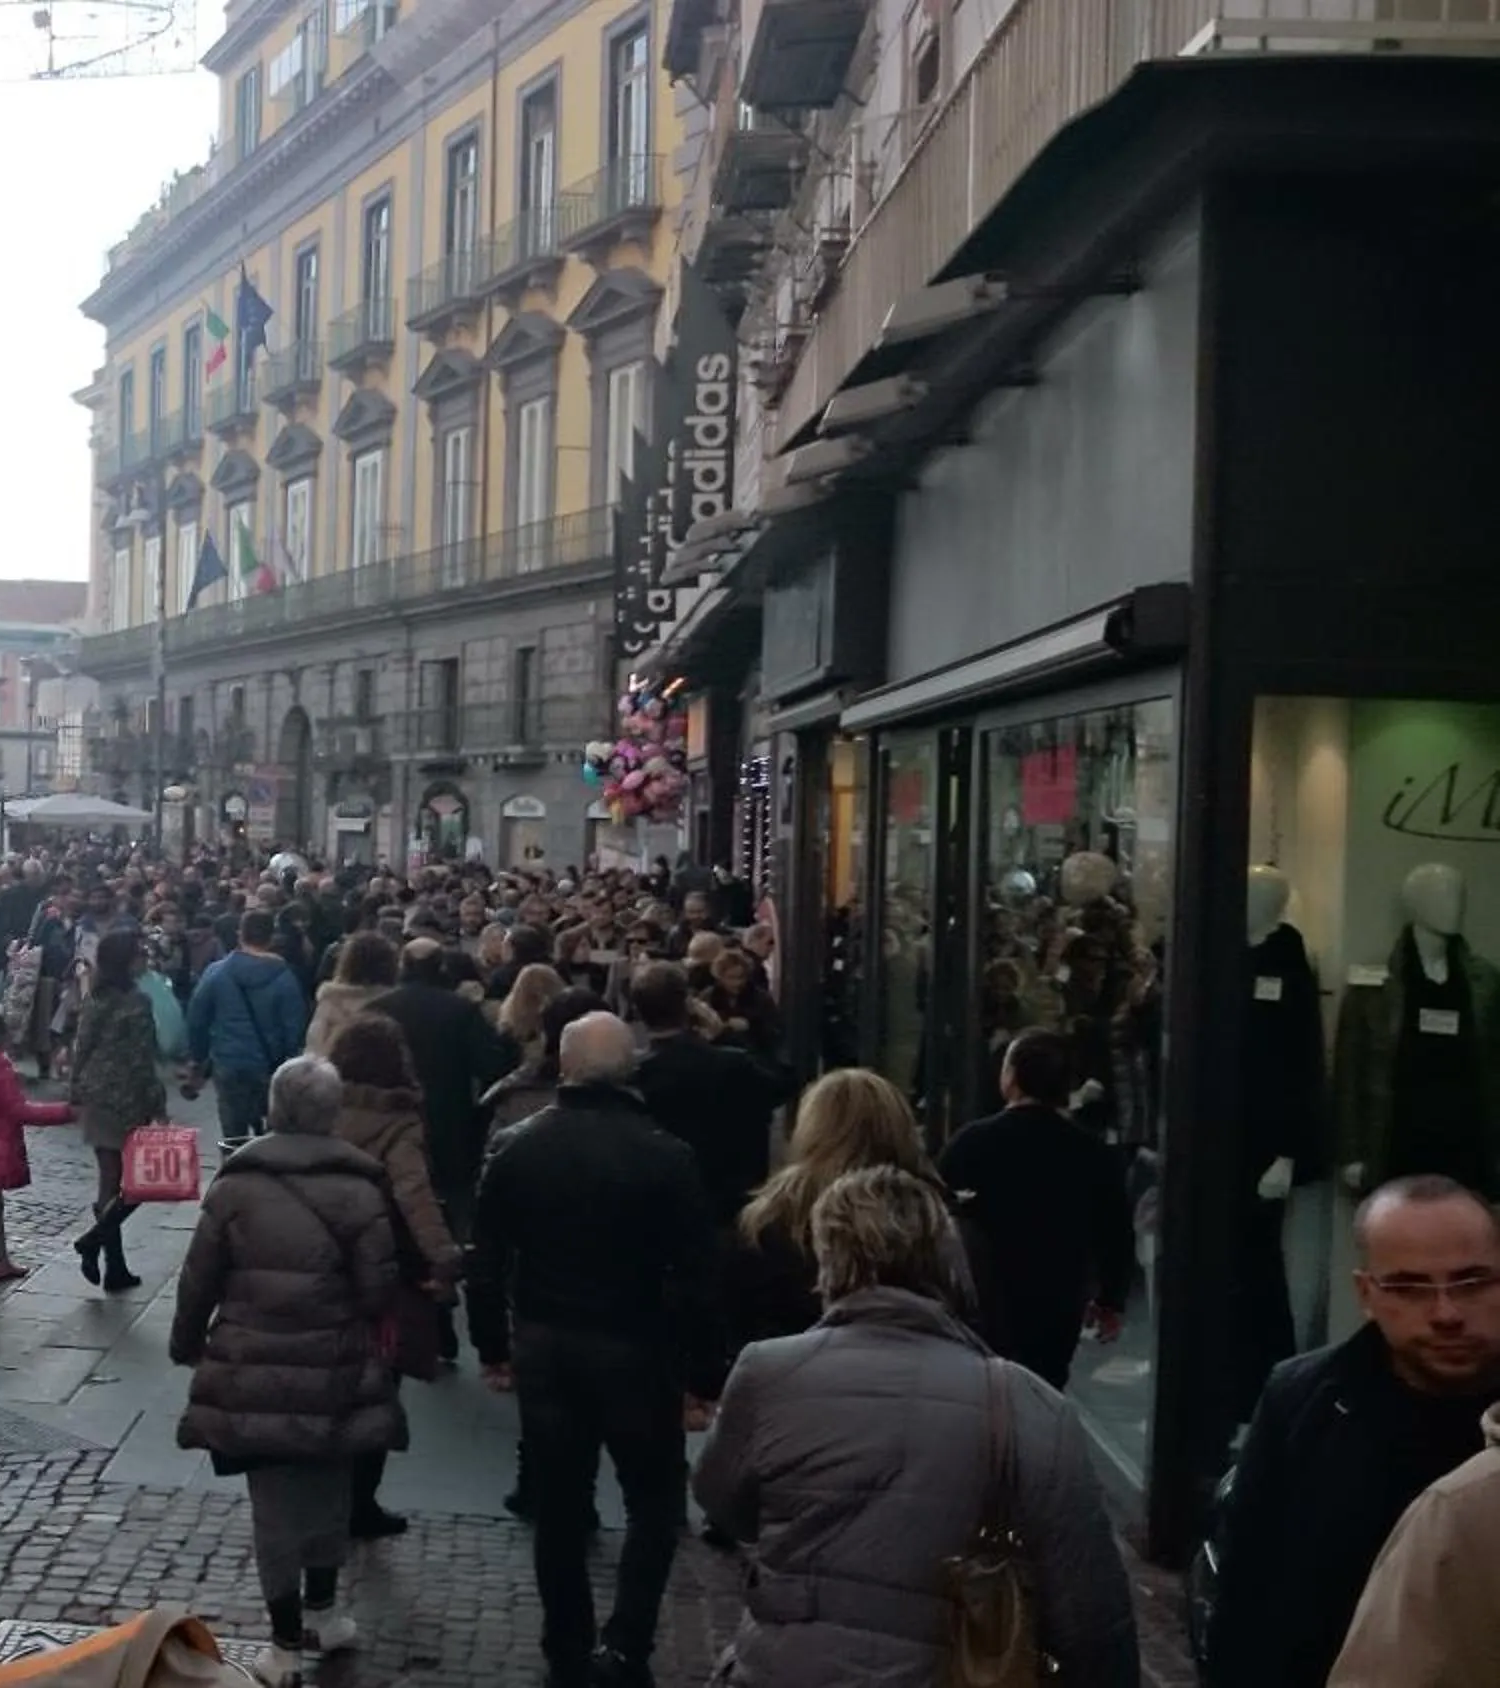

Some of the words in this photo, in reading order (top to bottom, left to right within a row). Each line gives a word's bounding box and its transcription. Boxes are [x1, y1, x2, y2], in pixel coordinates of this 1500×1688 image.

[683, 352, 731, 524] adidas
[1382, 762, 1500, 843] iM
[143, 1147, 182, 1183] 50
